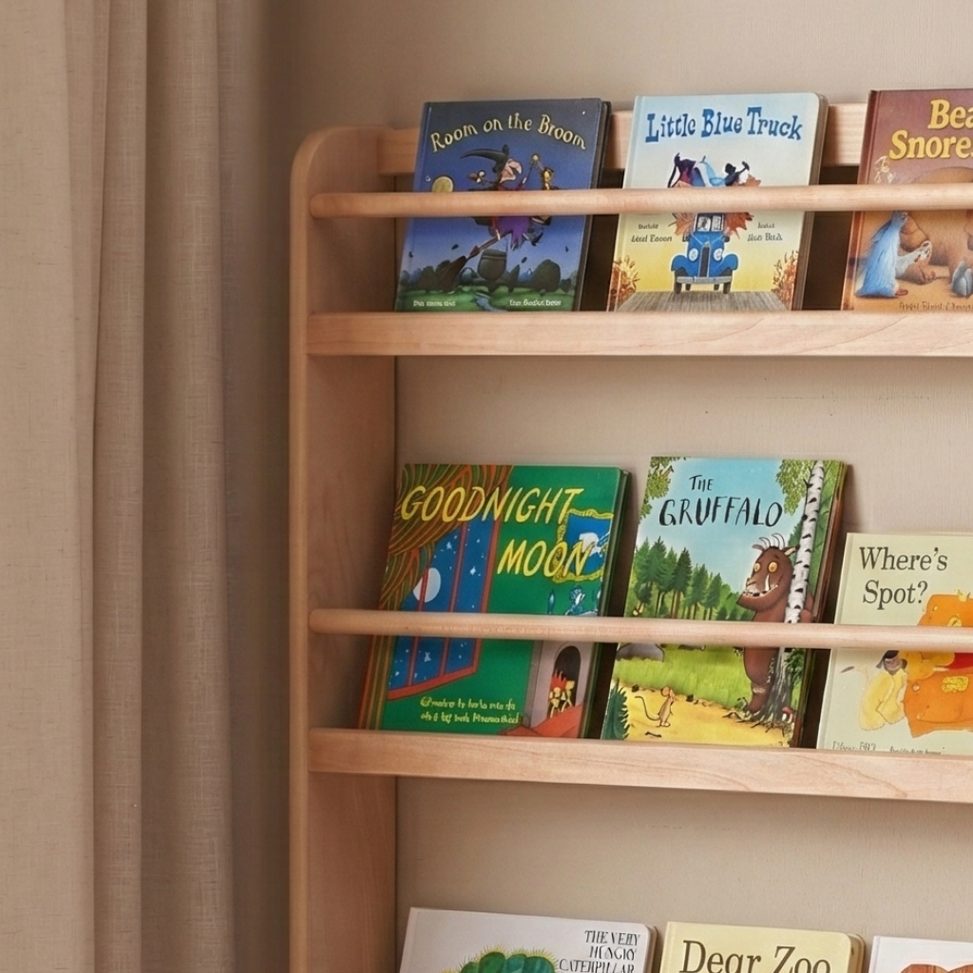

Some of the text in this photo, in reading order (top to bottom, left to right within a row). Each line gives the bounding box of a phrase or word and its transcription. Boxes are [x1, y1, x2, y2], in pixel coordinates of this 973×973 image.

[430, 112, 586, 152] Room on the Broom
[645, 107, 803, 142] Little Blue Truck
[689, 474, 714, 492] THE
[401, 486, 584, 524] GOODNIGHT
[658, 496, 782, 527] GRUFFALO
[496, 539, 596, 577] MOON
[860, 546, 948, 571] Where's
[862, 580, 928, 610] Spot?
[584, 930, 608, 944] THE
